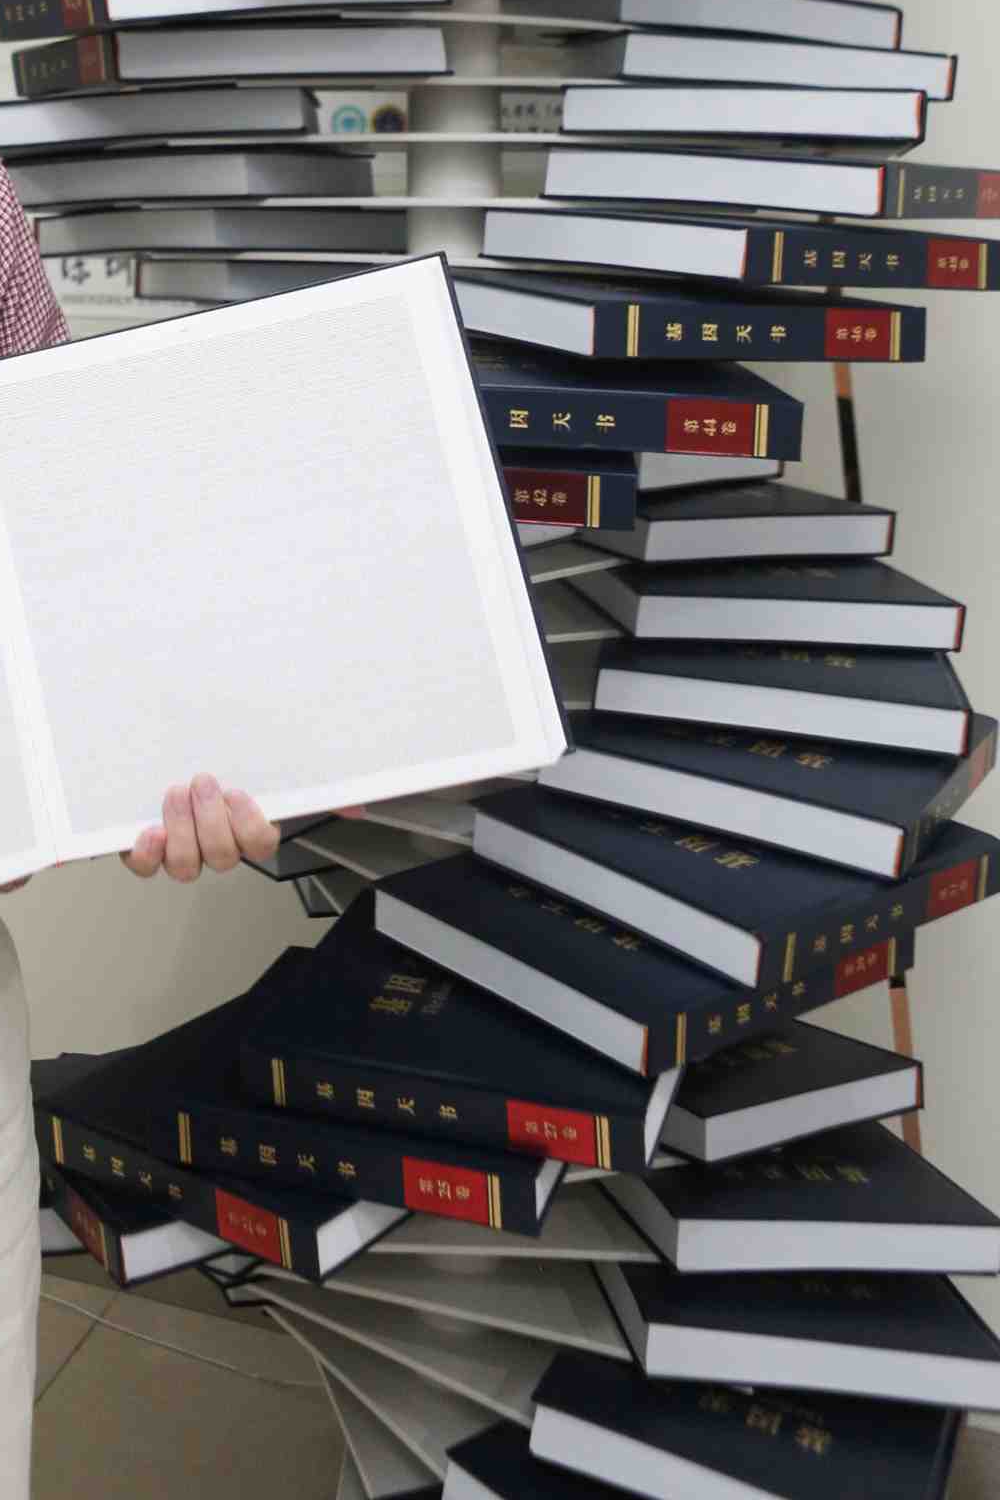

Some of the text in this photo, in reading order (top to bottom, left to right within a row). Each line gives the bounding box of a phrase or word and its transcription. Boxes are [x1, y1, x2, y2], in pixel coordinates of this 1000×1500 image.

[803, 250, 899, 269] 基因天书
[665, 322, 877, 343] 基因天书 第46卷
[509, 409, 737, 437] 因天书 第44卷
[514, 489, 567, 507] 第42卷
[316, 1083, 458, 1120] 基因天书
[220, 1137, 357, 1177] 基因天书
[82, 1144, 183, 1199] 基因天书
